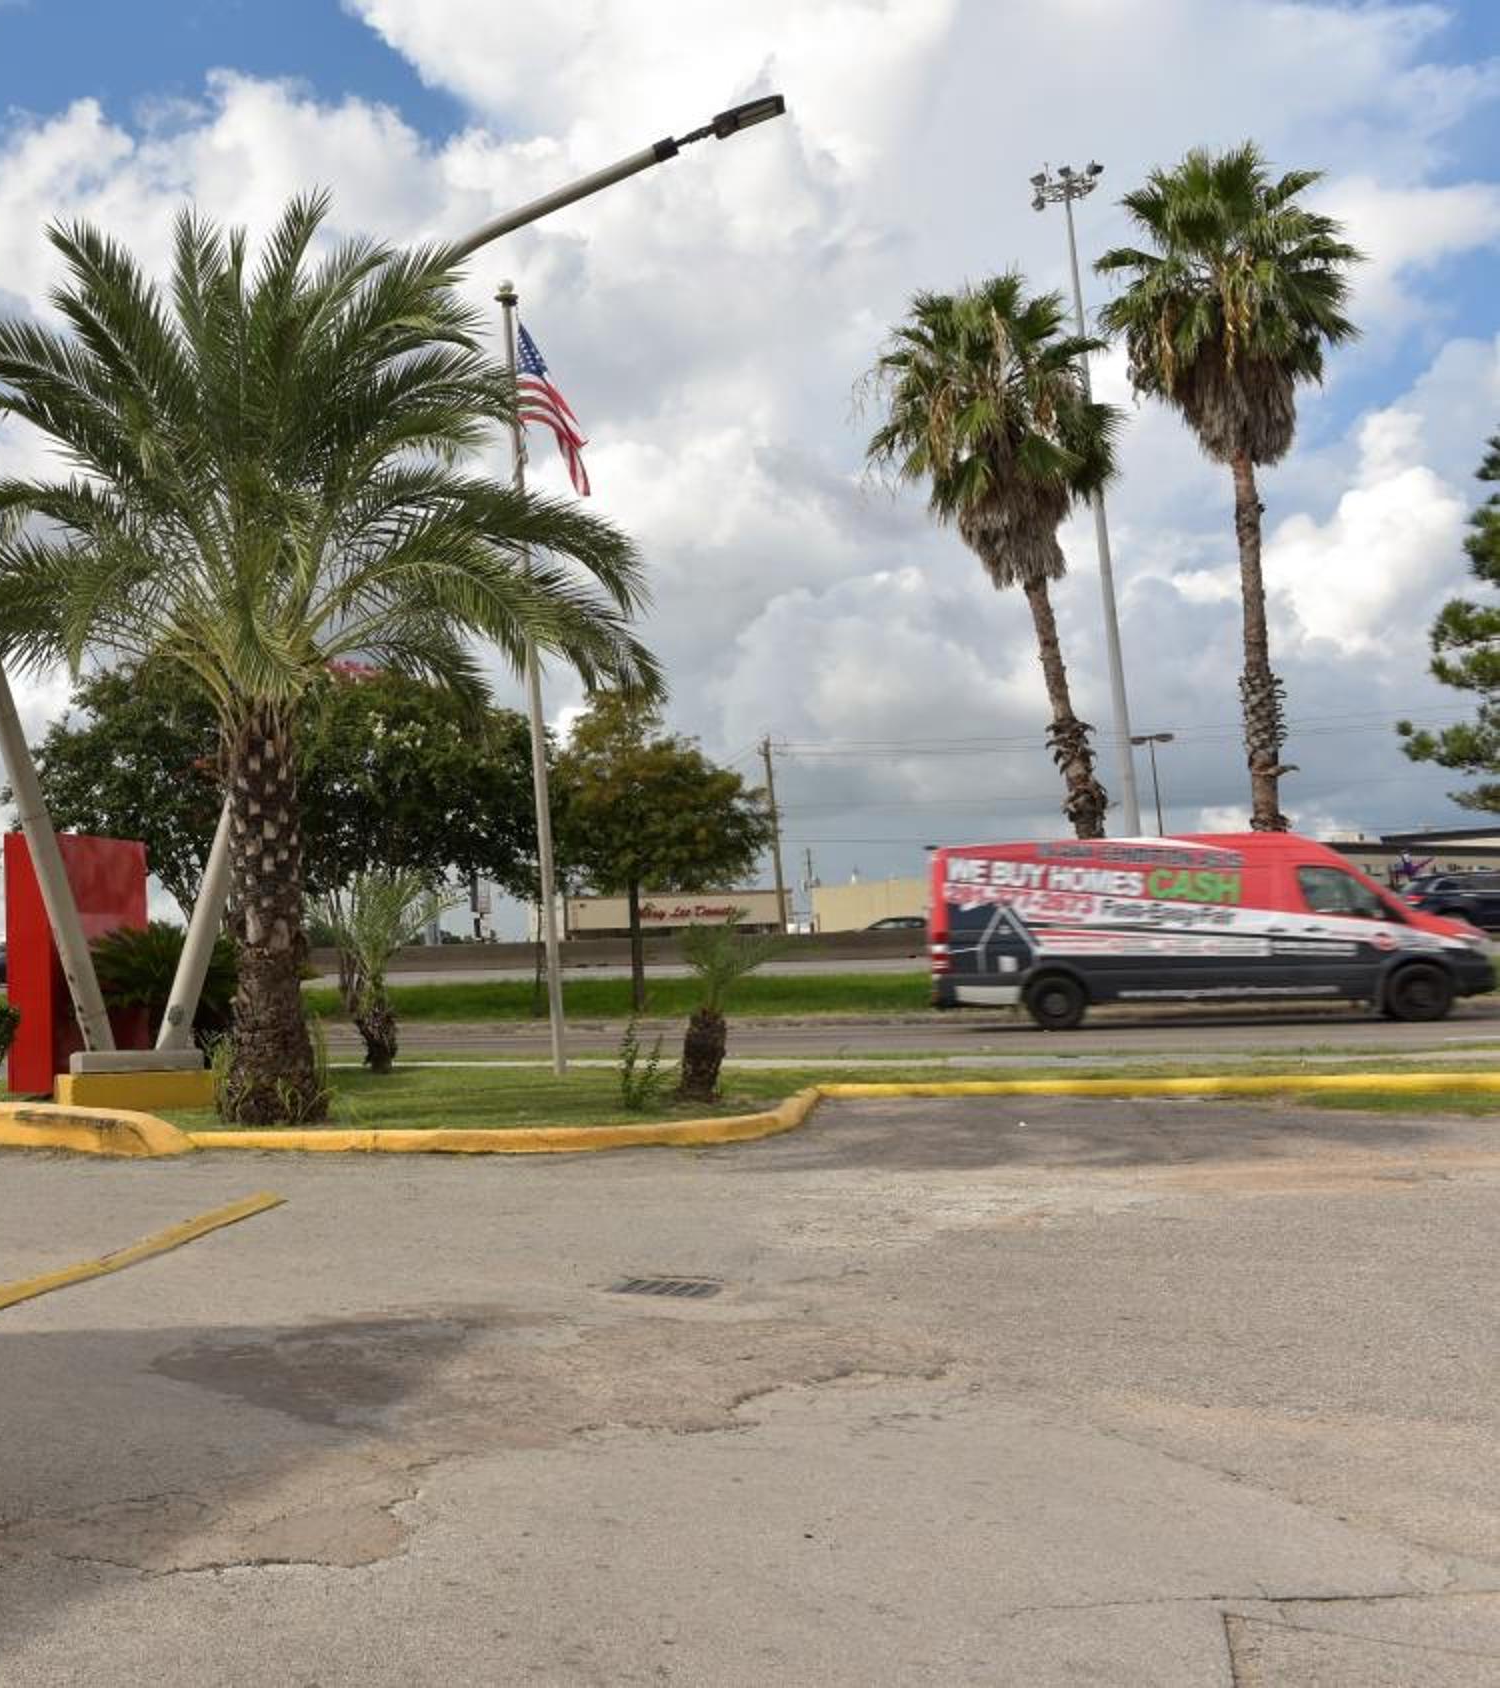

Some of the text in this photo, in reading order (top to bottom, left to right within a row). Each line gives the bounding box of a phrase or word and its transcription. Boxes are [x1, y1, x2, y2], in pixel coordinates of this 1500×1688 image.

[947, 858, 1239, 903] WE BUY HOMES CASH
